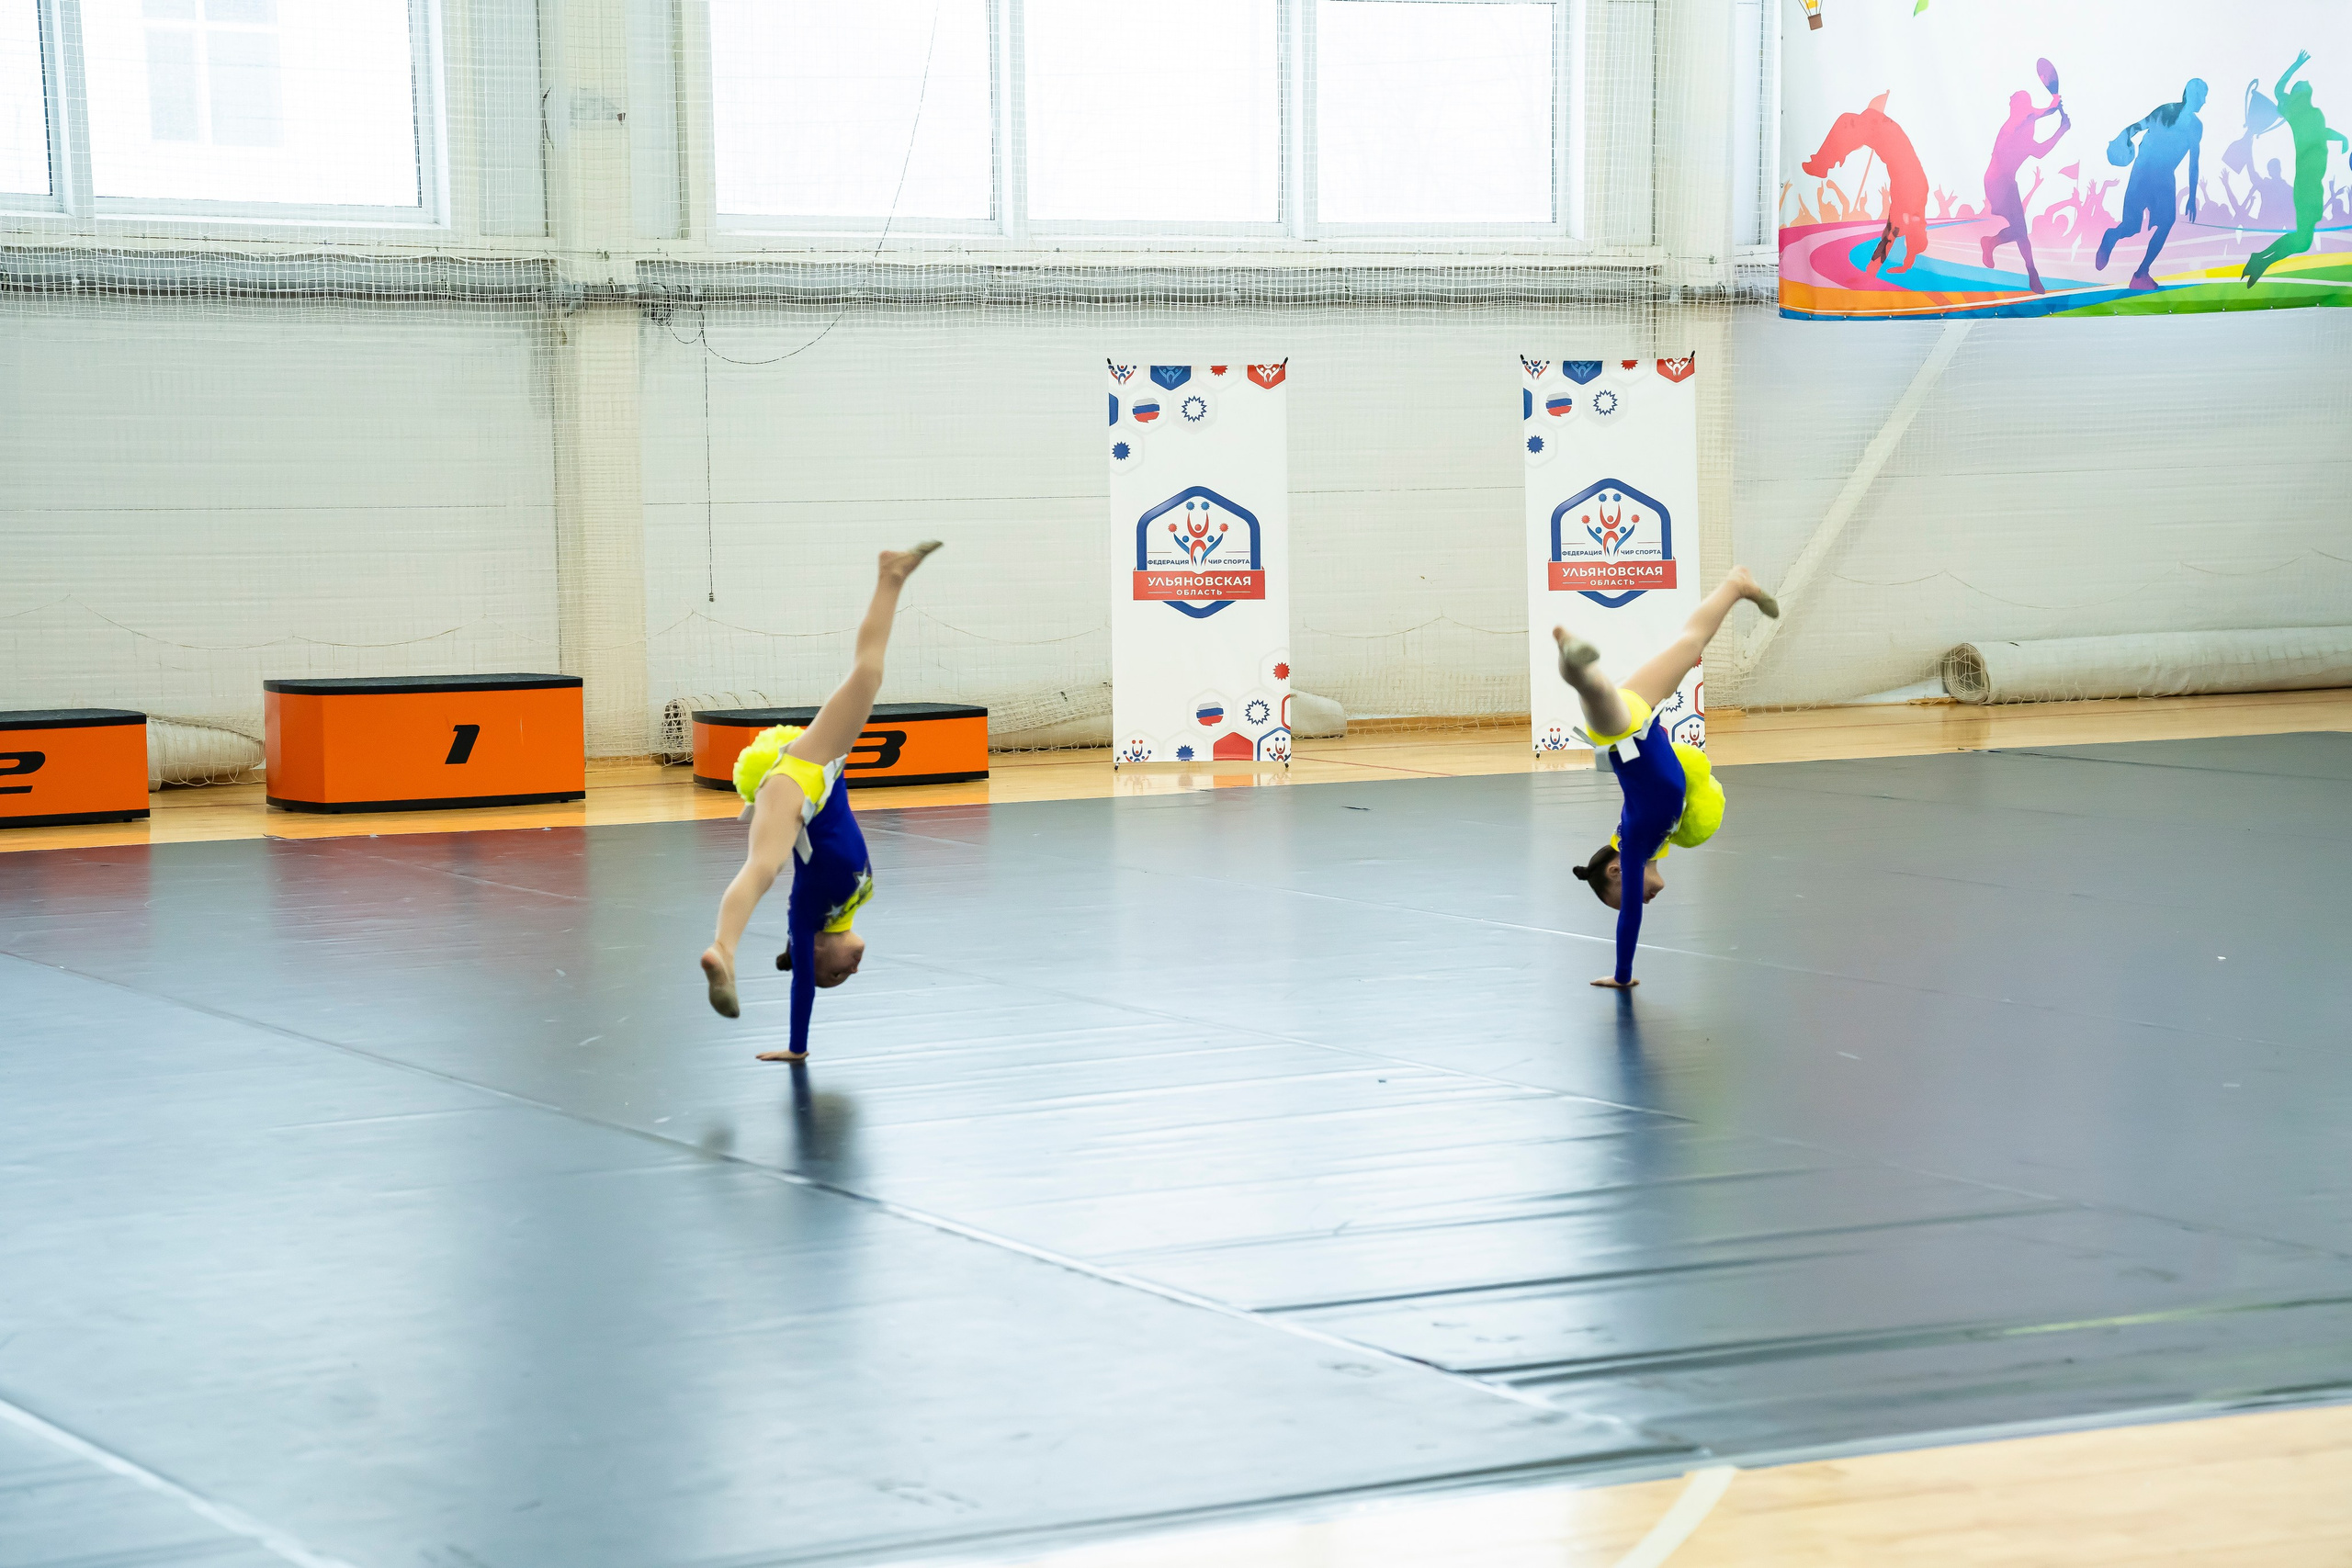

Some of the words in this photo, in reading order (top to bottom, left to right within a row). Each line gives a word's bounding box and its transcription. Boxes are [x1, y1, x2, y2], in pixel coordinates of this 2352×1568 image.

[1148, 576, 1251, 587] УЛЬЯНОВСКАЯ
[1562, 566, 1663, 577] УЛЬЯНОВСКАЯ
[445, 724, 481, 764] 1
[843, 730, 907, 770] 3
